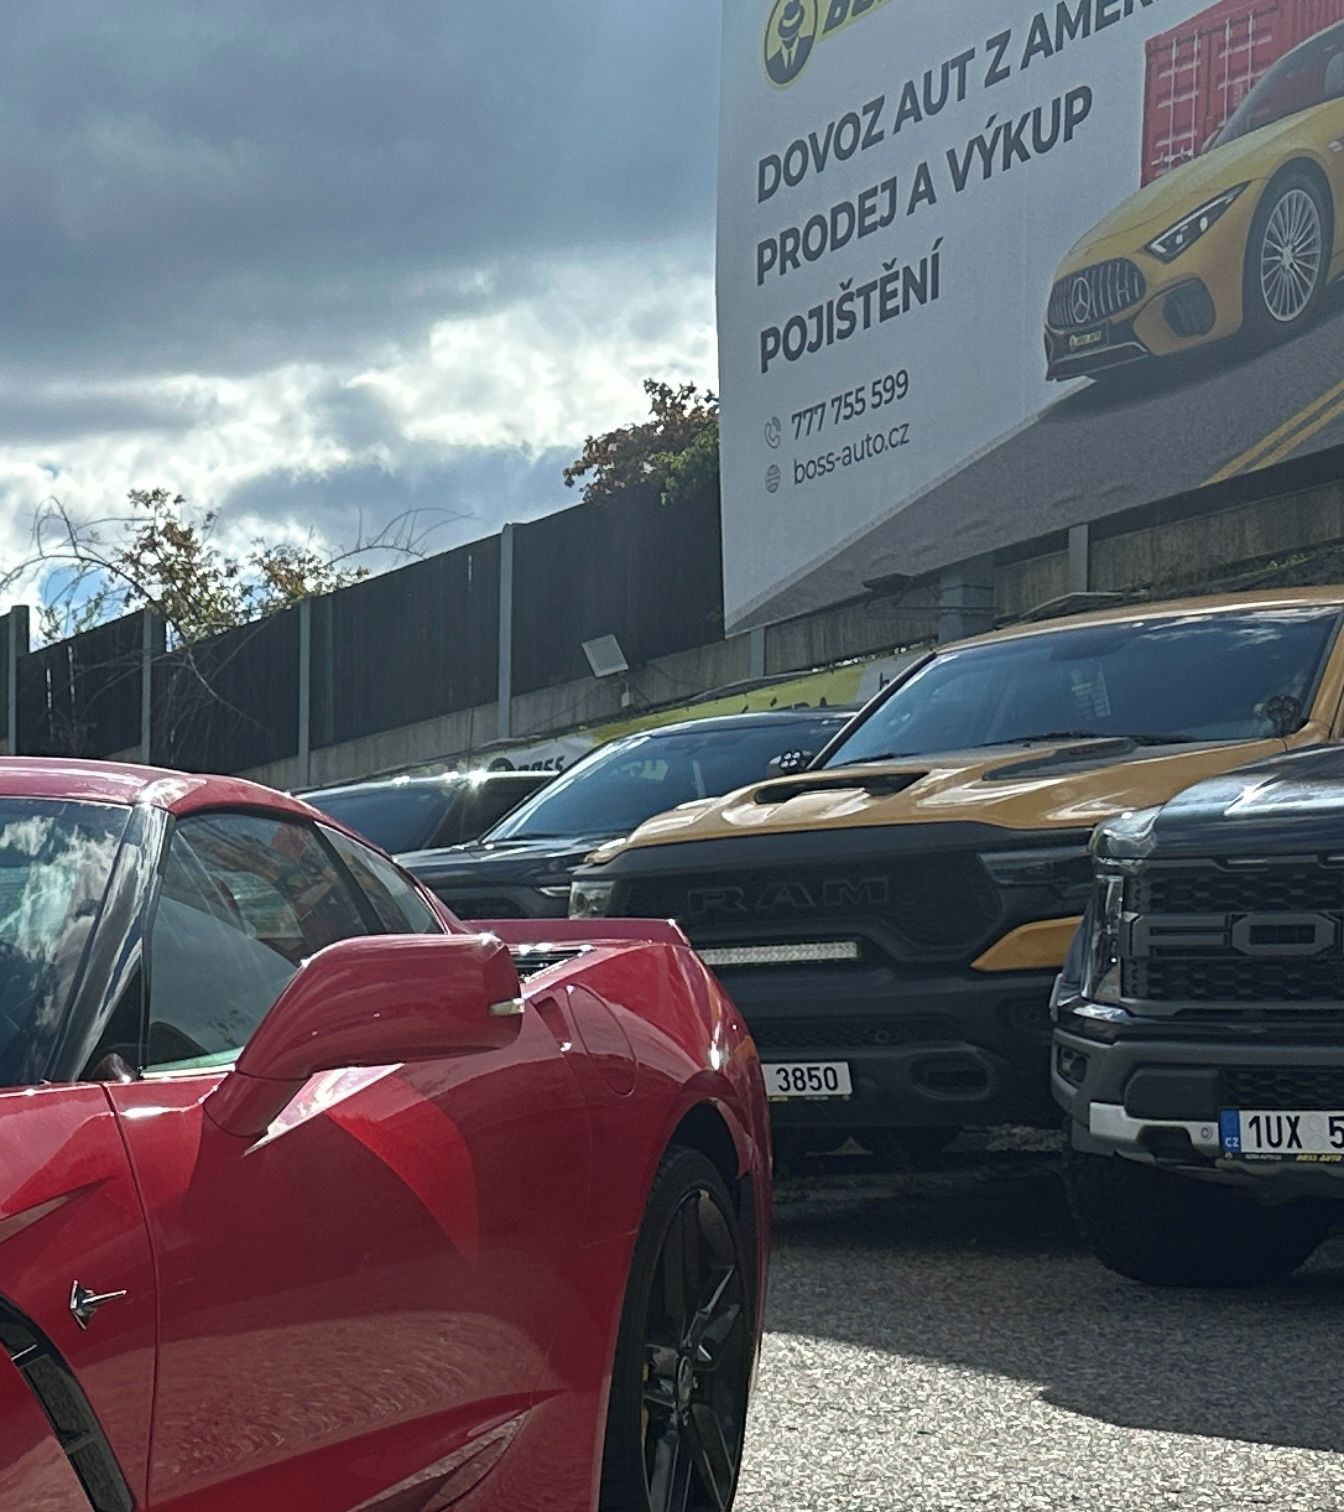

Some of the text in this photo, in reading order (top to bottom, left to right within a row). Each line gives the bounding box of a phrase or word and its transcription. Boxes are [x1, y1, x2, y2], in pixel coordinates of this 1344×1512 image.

[757, 94, 886, 204] DOVOZ
[892, 47, 976, 135] AUT
[984, 28, 1012, 89] Z
[757, 84, 1094, 287] PRODEJ A VÝKUP
[760, 235, 945, 374] POJIŠTĚNÍ
[791, 369, 909, 441] 777 755 599
[793, 422, 911, 486] boss-auto.cz
[687, 877, 889, 914] RAM
[775, 1066, 839, 1092] 3850
[1224, 1136, 1240, 1148] CZ
[1248, 1115, 1303, 1149] 1UX
